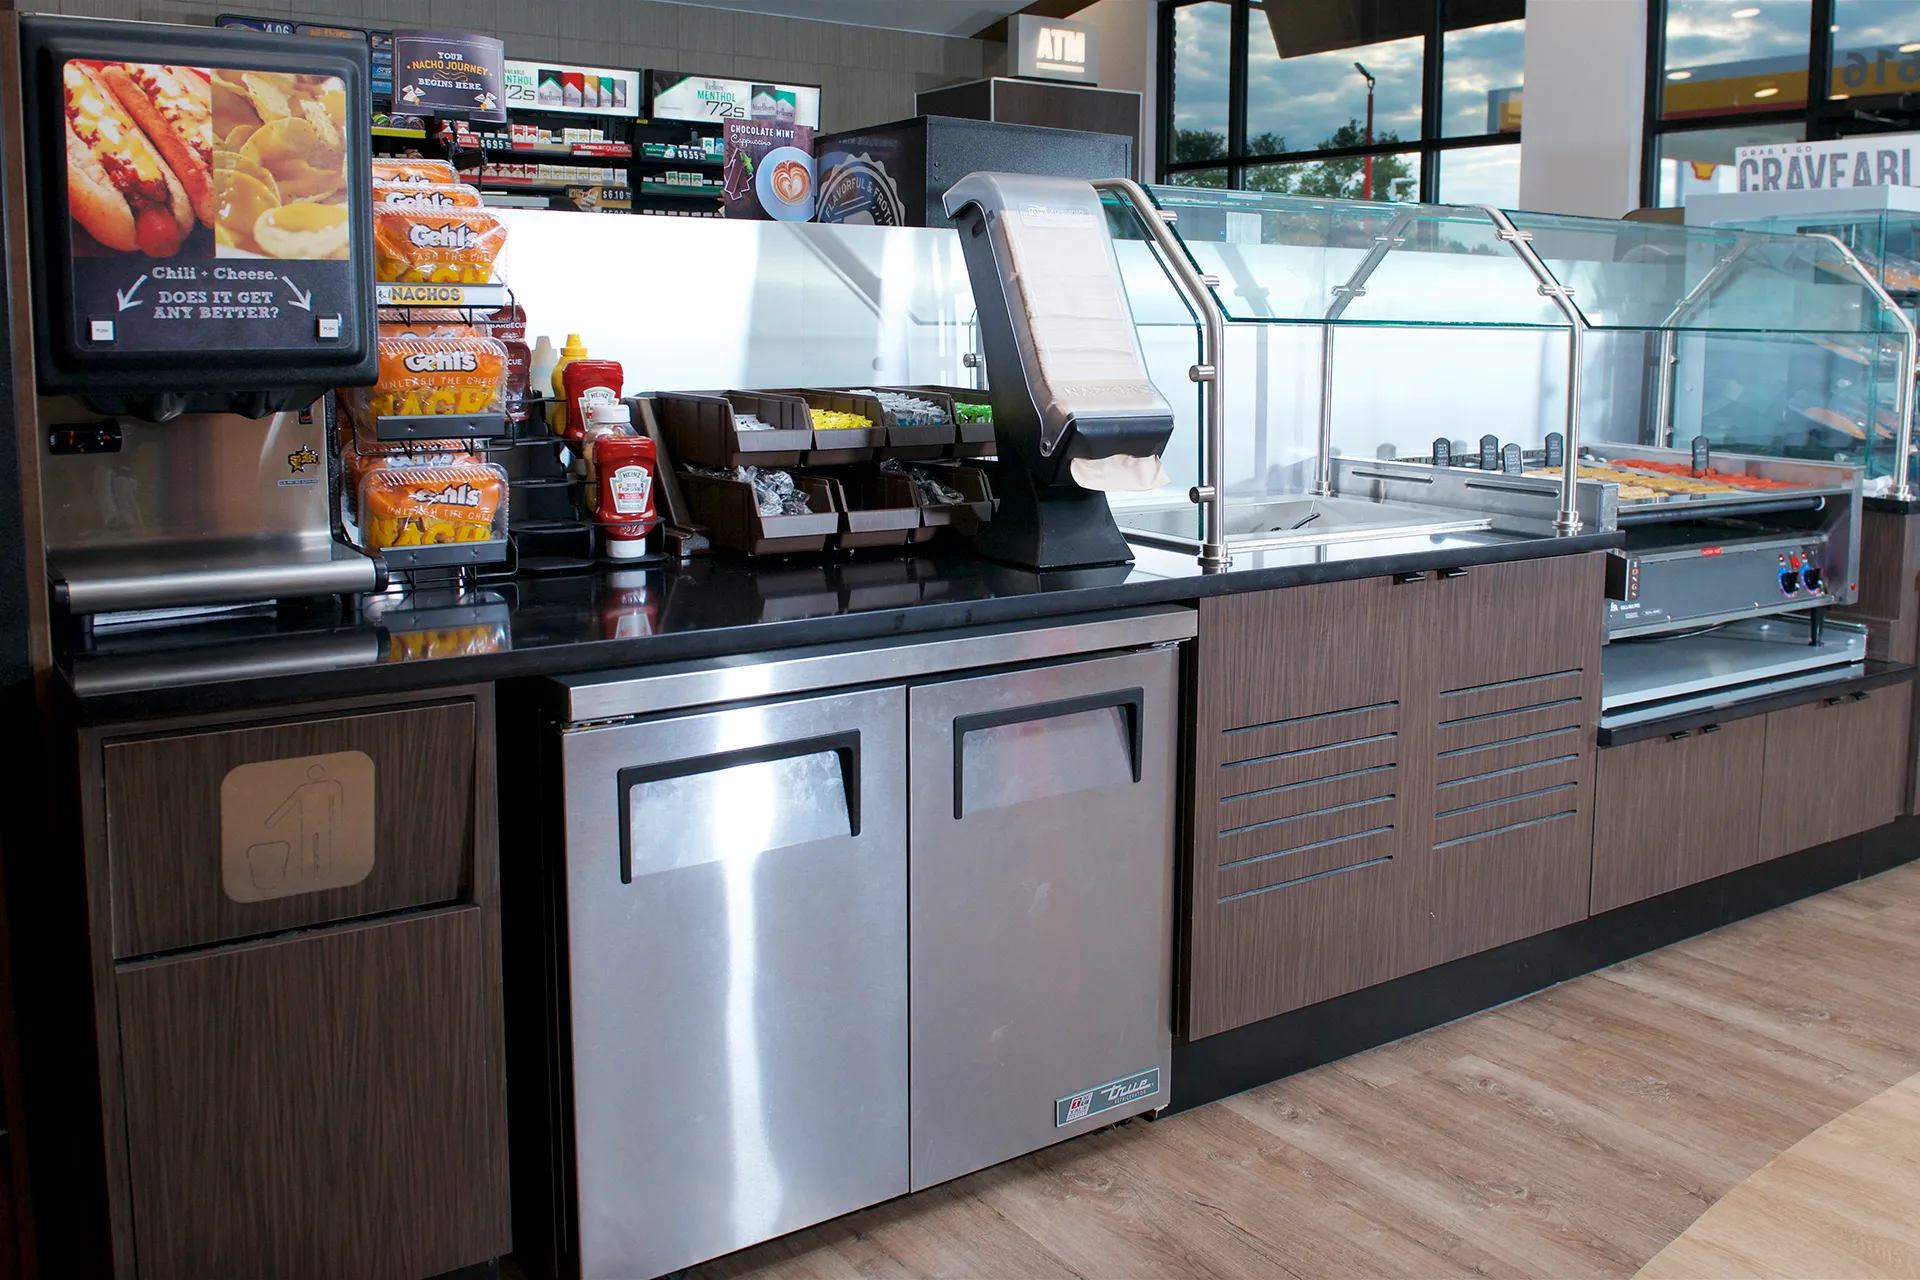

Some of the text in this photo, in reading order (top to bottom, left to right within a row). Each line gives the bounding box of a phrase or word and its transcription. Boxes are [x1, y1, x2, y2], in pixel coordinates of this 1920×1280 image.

[1036, 27, 1086, 63] ATM
[437, 52, 463, 61] YOUR
[412, 60, 489, 75] NACHO JOURNEY
[418, 78, 483, 91] BEGINS HERE.
[697, 90, 737, 103] MENTHOL
[706, 101, 745, 118] 72s
[730, 124, 795, 139] CHOCOLATE MINT
[730, 134, 772, 147] Cappuccino
[1741, 145, 1813, 157] GRAB & GO
[825, 176, 866, 218] FLAVORFUL
[866, 181, 873, 194] &
[408, 221, 480, 249] Gehl's
[445, 252, 465, 261] THE
[152, 267, 197, 280] Chili
[213, 267, 278, 280] Cheese.
[158, 291, 274, 304] DOES IT GET
[391, 287, 461, 302] NACHOS
[153, 306, 279, 319] ANY BETTER?
[404, 349, 478, 372] Gehl's
[441, 376, 461, 385] THE
[590, 391, 609, 399] HEINZ
